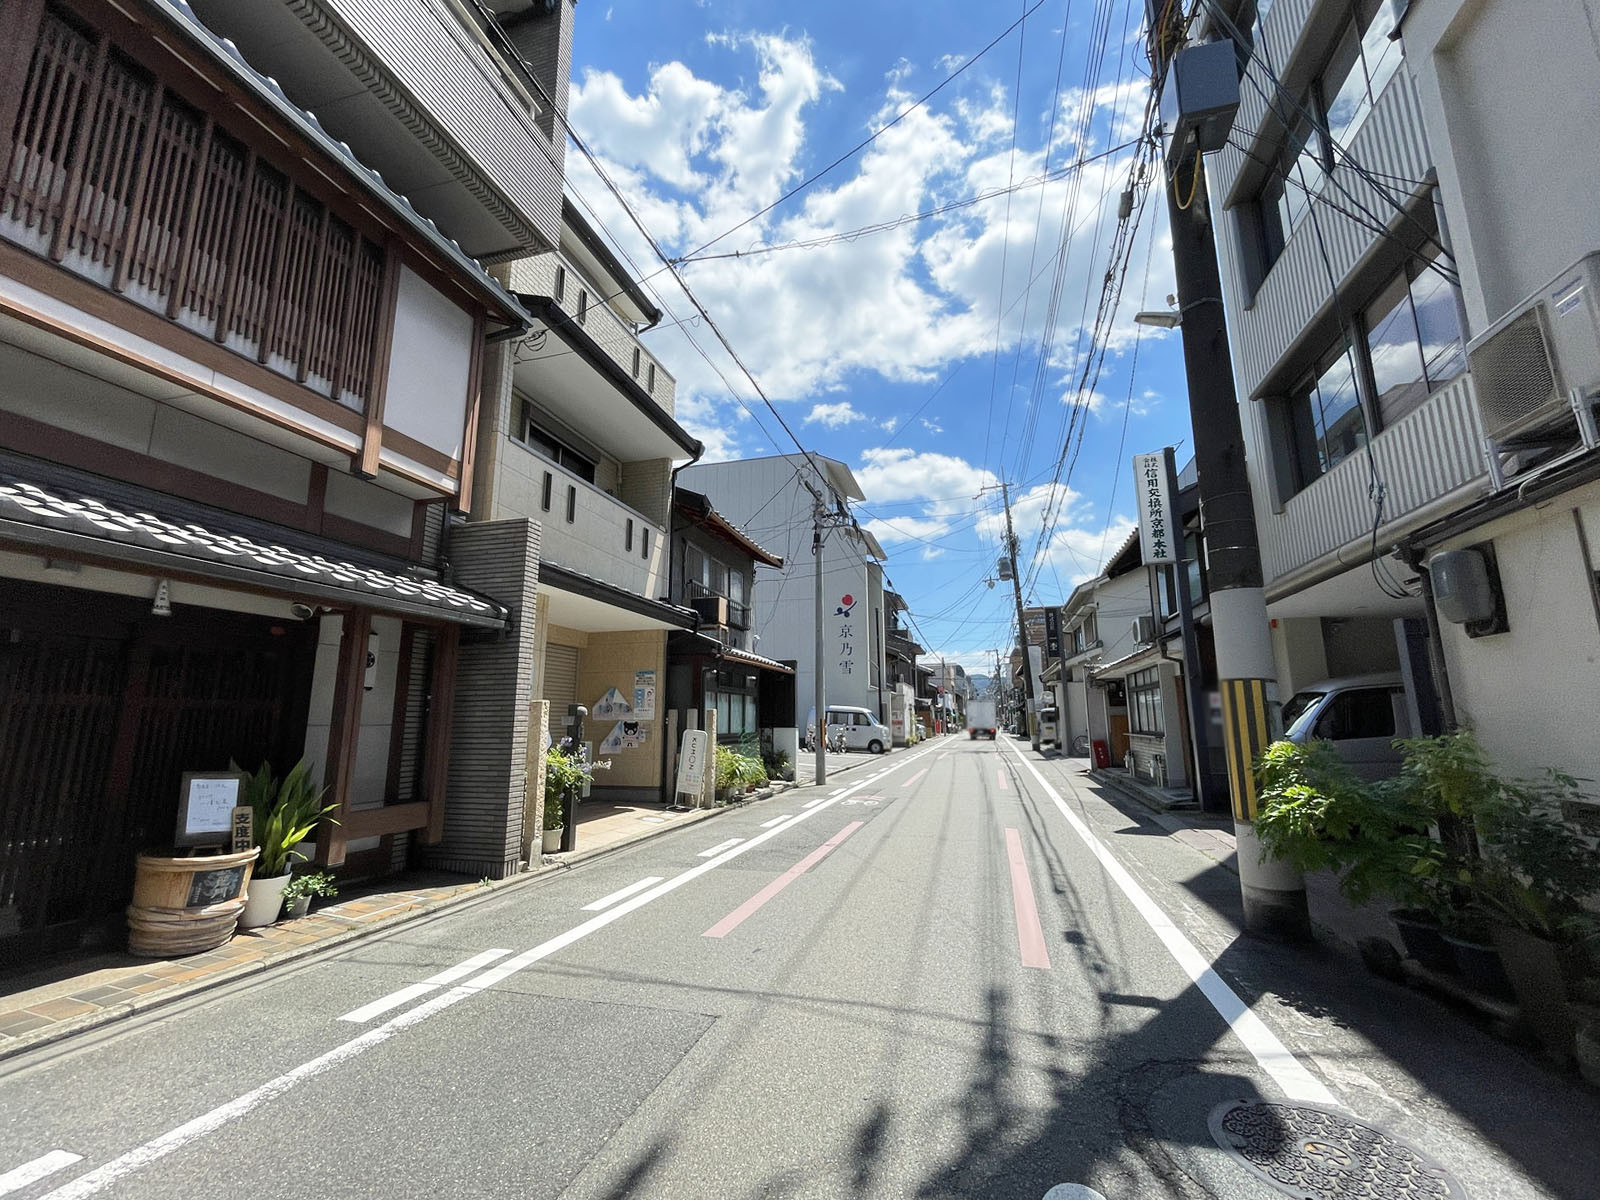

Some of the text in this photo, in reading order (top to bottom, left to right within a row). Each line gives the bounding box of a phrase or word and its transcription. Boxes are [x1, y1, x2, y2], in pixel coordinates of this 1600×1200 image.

[839, 624, 853, 675] 京乃雪
[235, 813, 251, 851] 支度中
